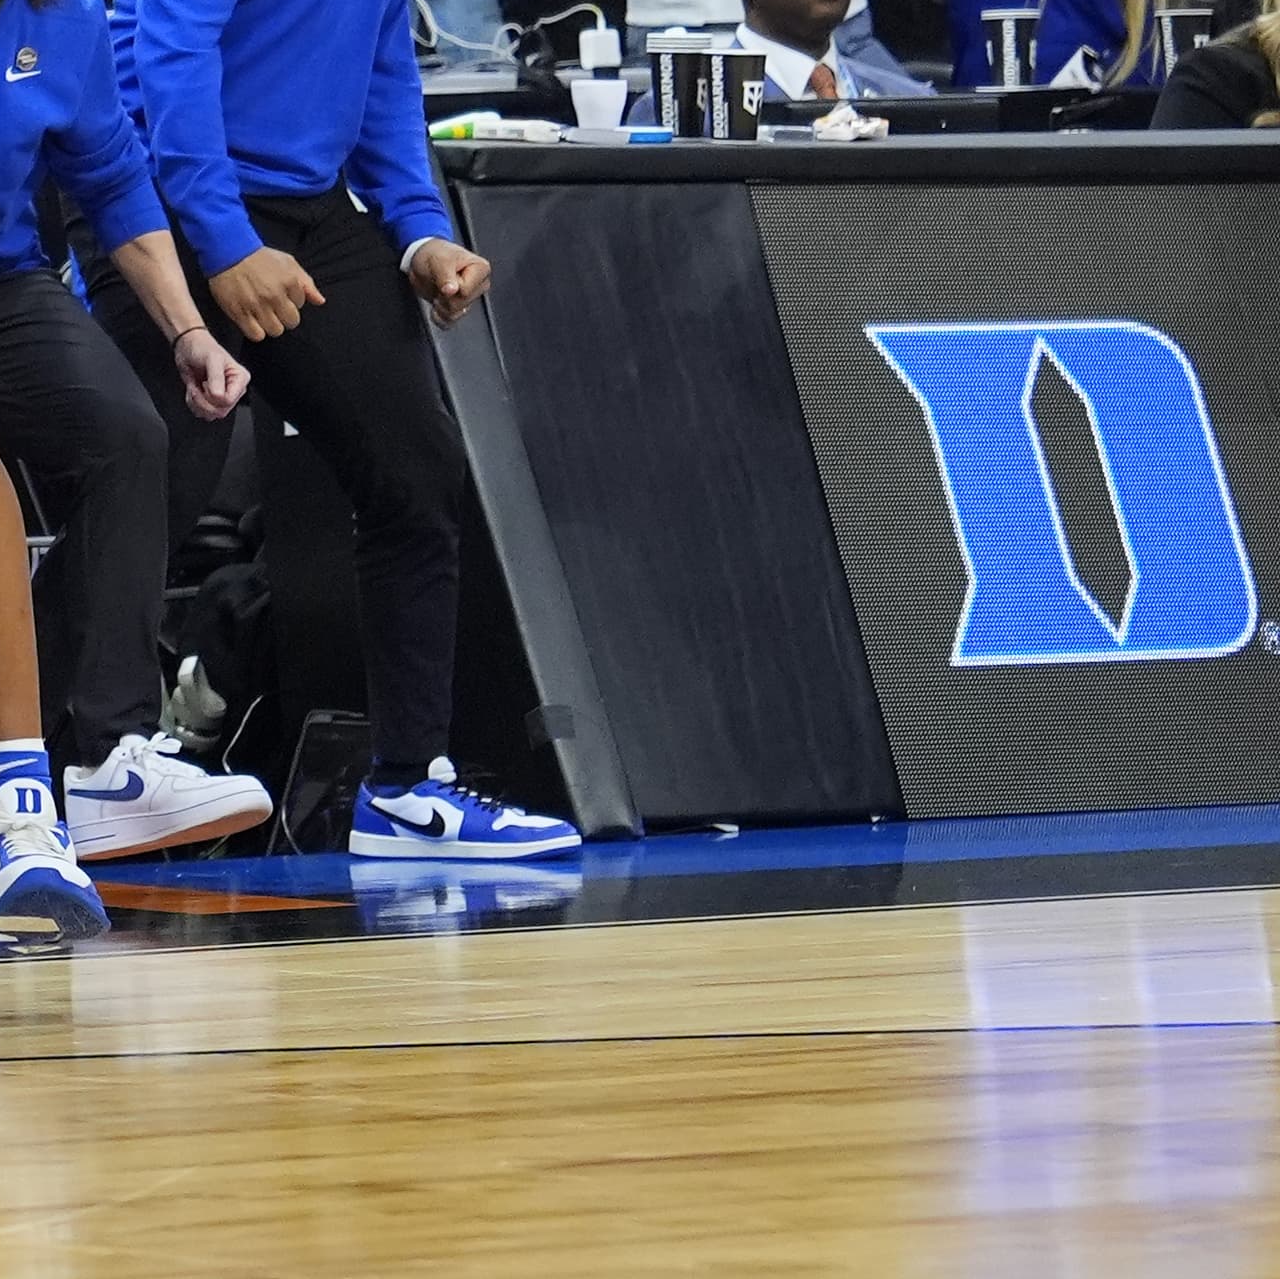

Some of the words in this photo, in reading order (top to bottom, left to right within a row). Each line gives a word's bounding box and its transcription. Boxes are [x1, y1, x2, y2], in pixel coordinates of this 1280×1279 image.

[659, 53, 674, 128] ODYARMOR
[710, 55, 724, 139] BODYARMOR
[863, 320, 1258, 667] D
[14, 786, 42, 814] D
